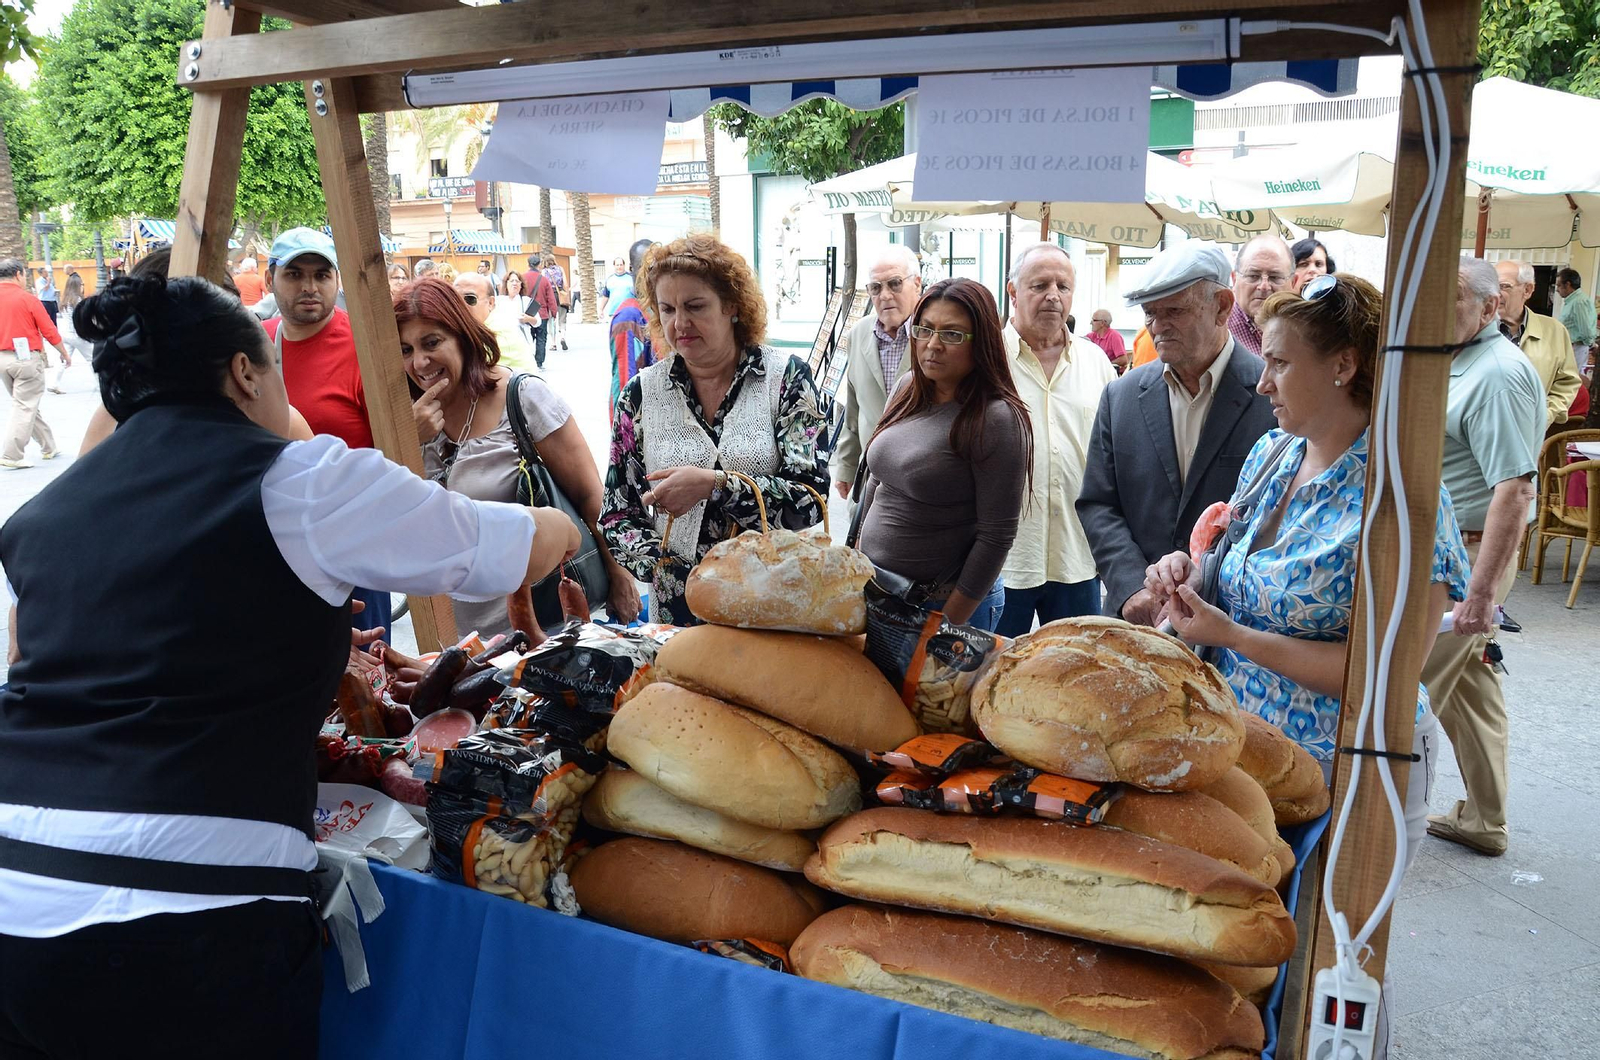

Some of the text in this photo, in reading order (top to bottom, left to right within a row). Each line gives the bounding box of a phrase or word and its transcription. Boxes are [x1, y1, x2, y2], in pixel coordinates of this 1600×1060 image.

[719, 51, 734, 60] KDE
[1467, 160, 1546, 181] eineken
[1264, 179, 1322, 194] Heineken
[824, 189, 892, 209] TIO MATEO
[529, 664, 577, 687] ARTESANA
[449, 748, 497, 766] ARTESANA
